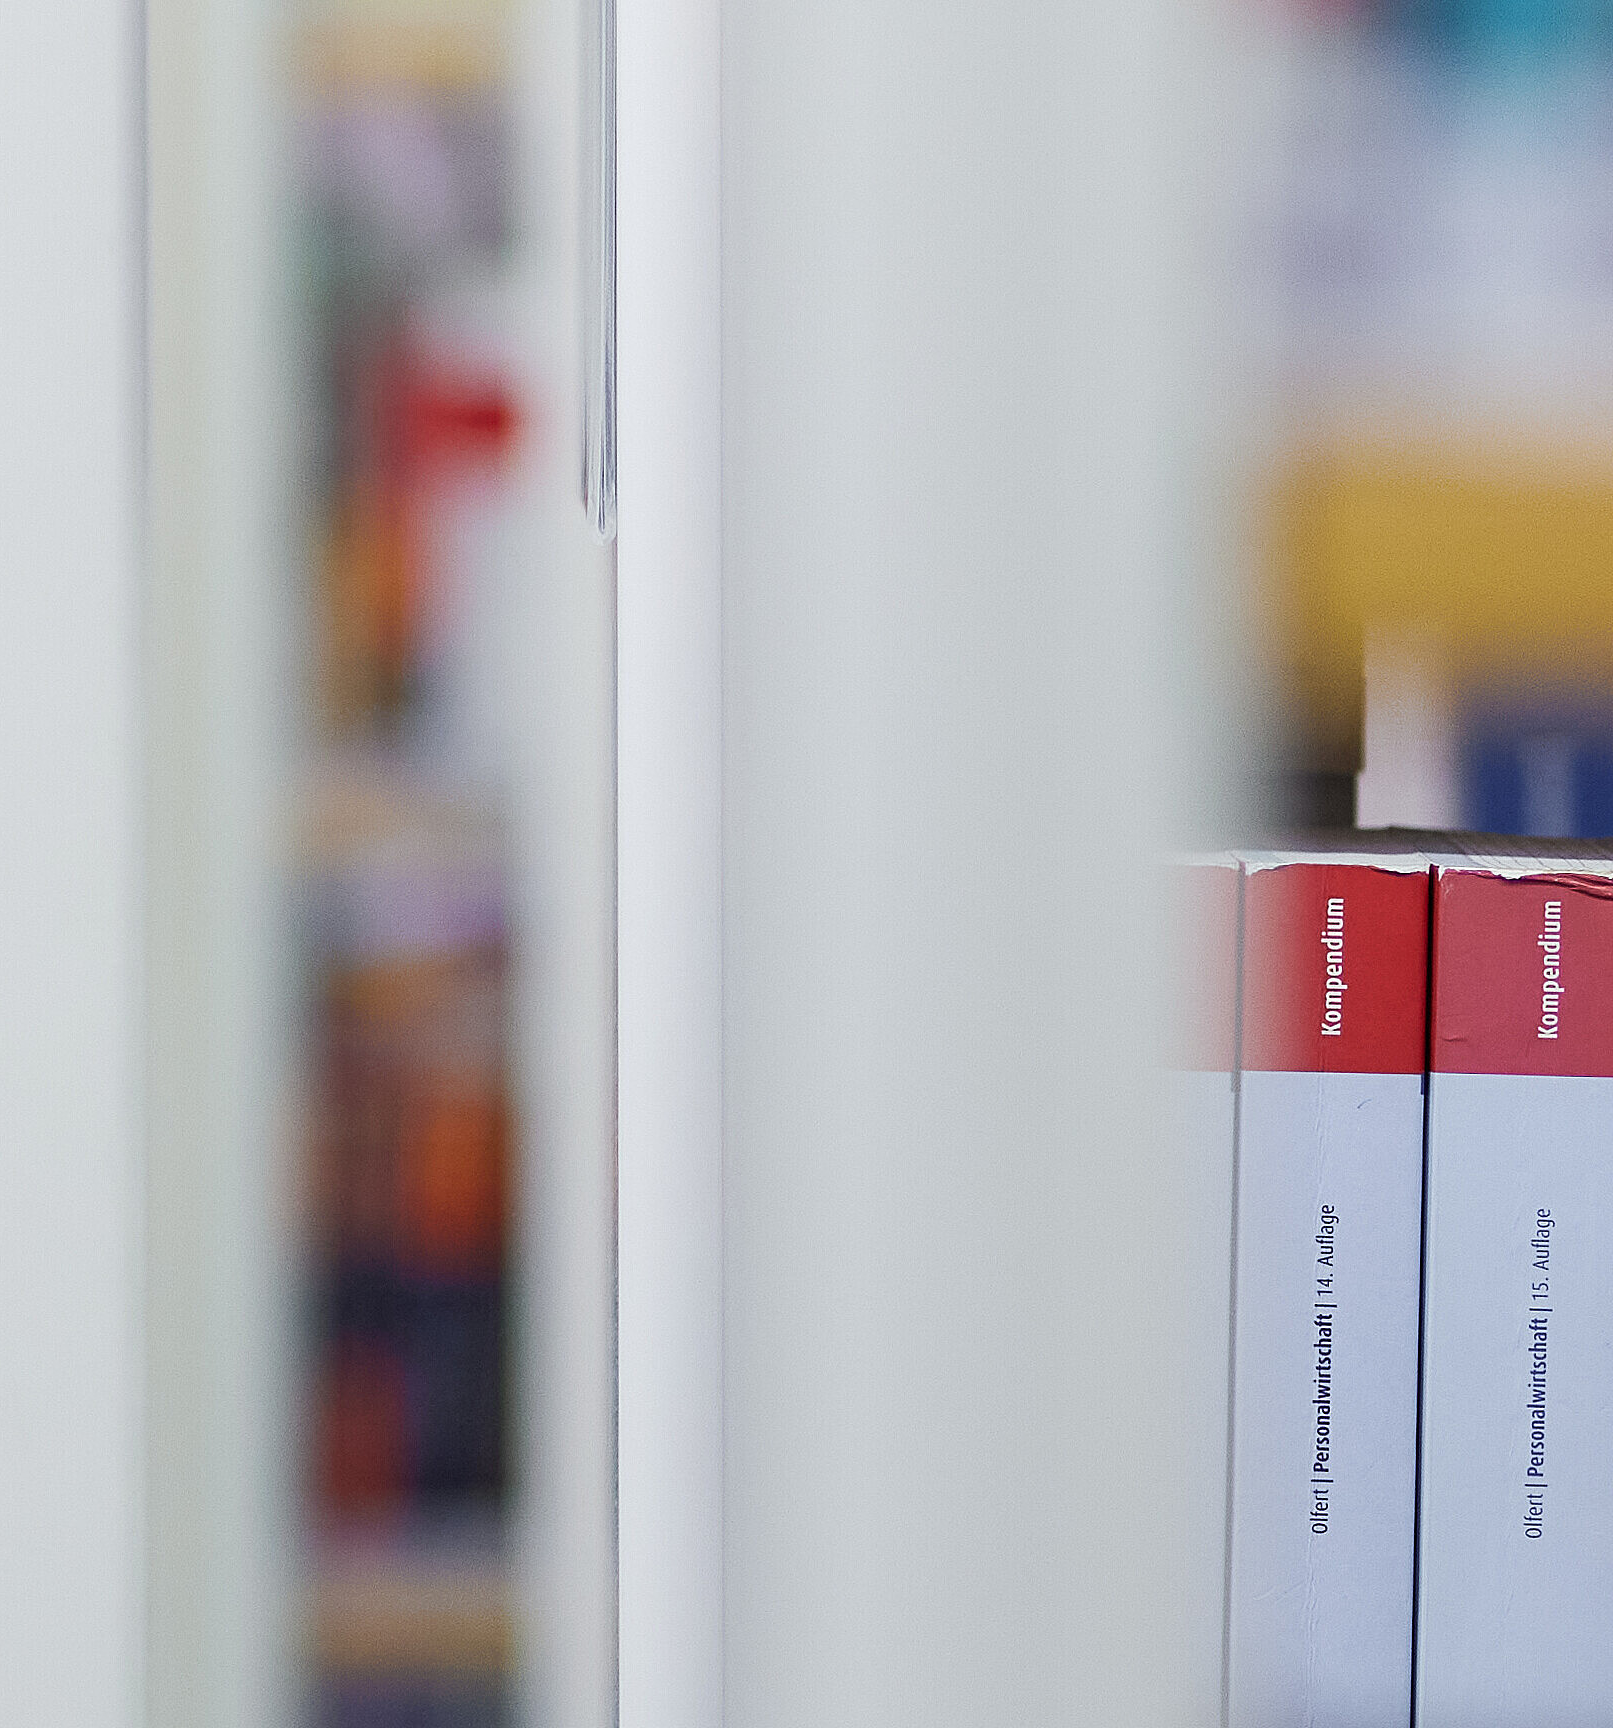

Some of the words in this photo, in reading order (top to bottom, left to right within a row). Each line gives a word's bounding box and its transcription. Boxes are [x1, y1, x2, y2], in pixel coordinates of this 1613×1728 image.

[1321, 898, 1348, 1036] Kompendium
[1537, 901, 1564, 1039] Kompendium
[1315, 1204, 1339, 1267] Auflage
[1531, 1208, 1555, 1270] Auflage
[1316, 1273, 1334, 1297] 14.
[1532, 1277, 1549, 1301] 15.
[1312, 1314, 1333, 1473] Personalwirtschaft
[1527, 1318, 1548, 1477] Personalwirtschaft
[1310, 1489, 1329, 1534] Olfert
[1524, 1493, 1543, 1539] Olfert
